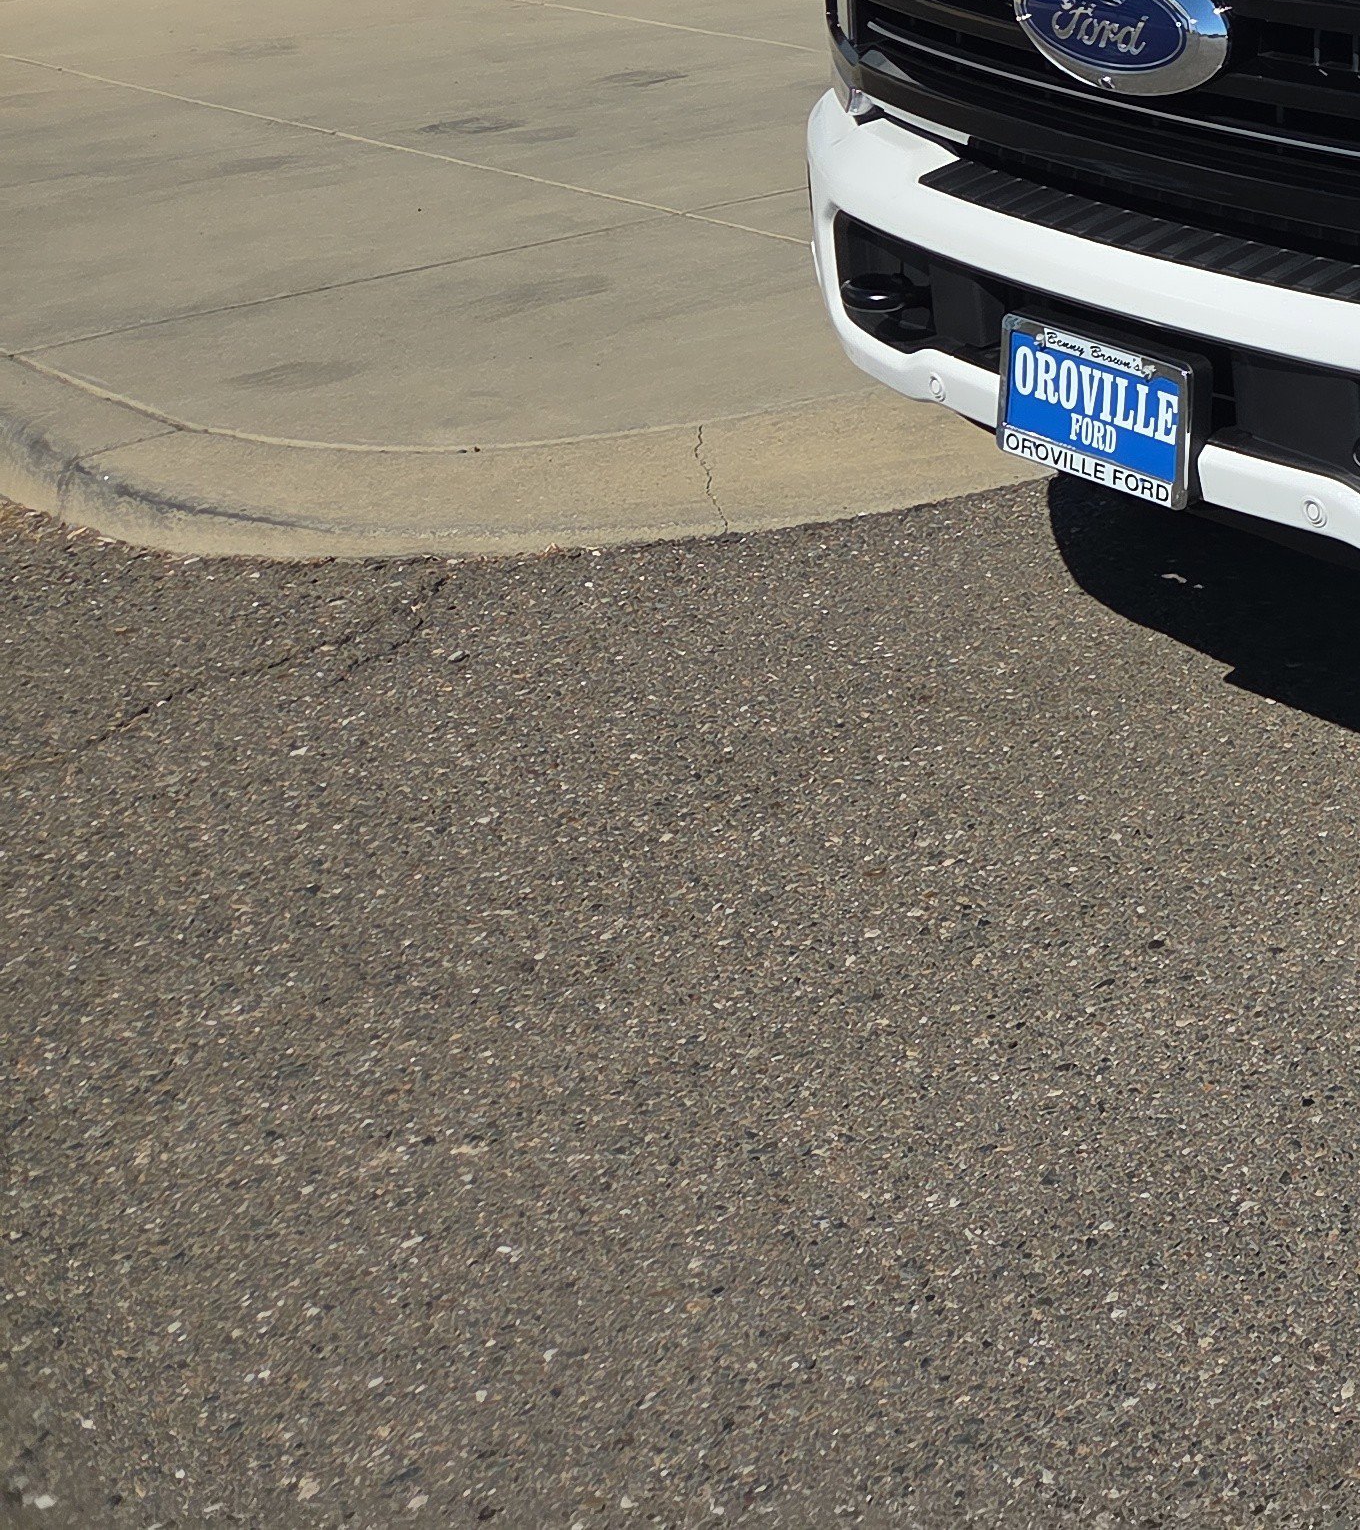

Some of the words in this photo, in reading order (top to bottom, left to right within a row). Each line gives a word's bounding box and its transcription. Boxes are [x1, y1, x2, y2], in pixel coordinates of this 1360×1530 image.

[1046, 332, 1085, 356] Benny
[1090, 345, 1140, 372] Brown's
[1014, 346, 1178, 445] OROVILLE
[1070, 413, 1117, 453] FORD
[1006, 434, 1105, 481] OROVILLE
[1112, 472, 1170, 502] FORD
